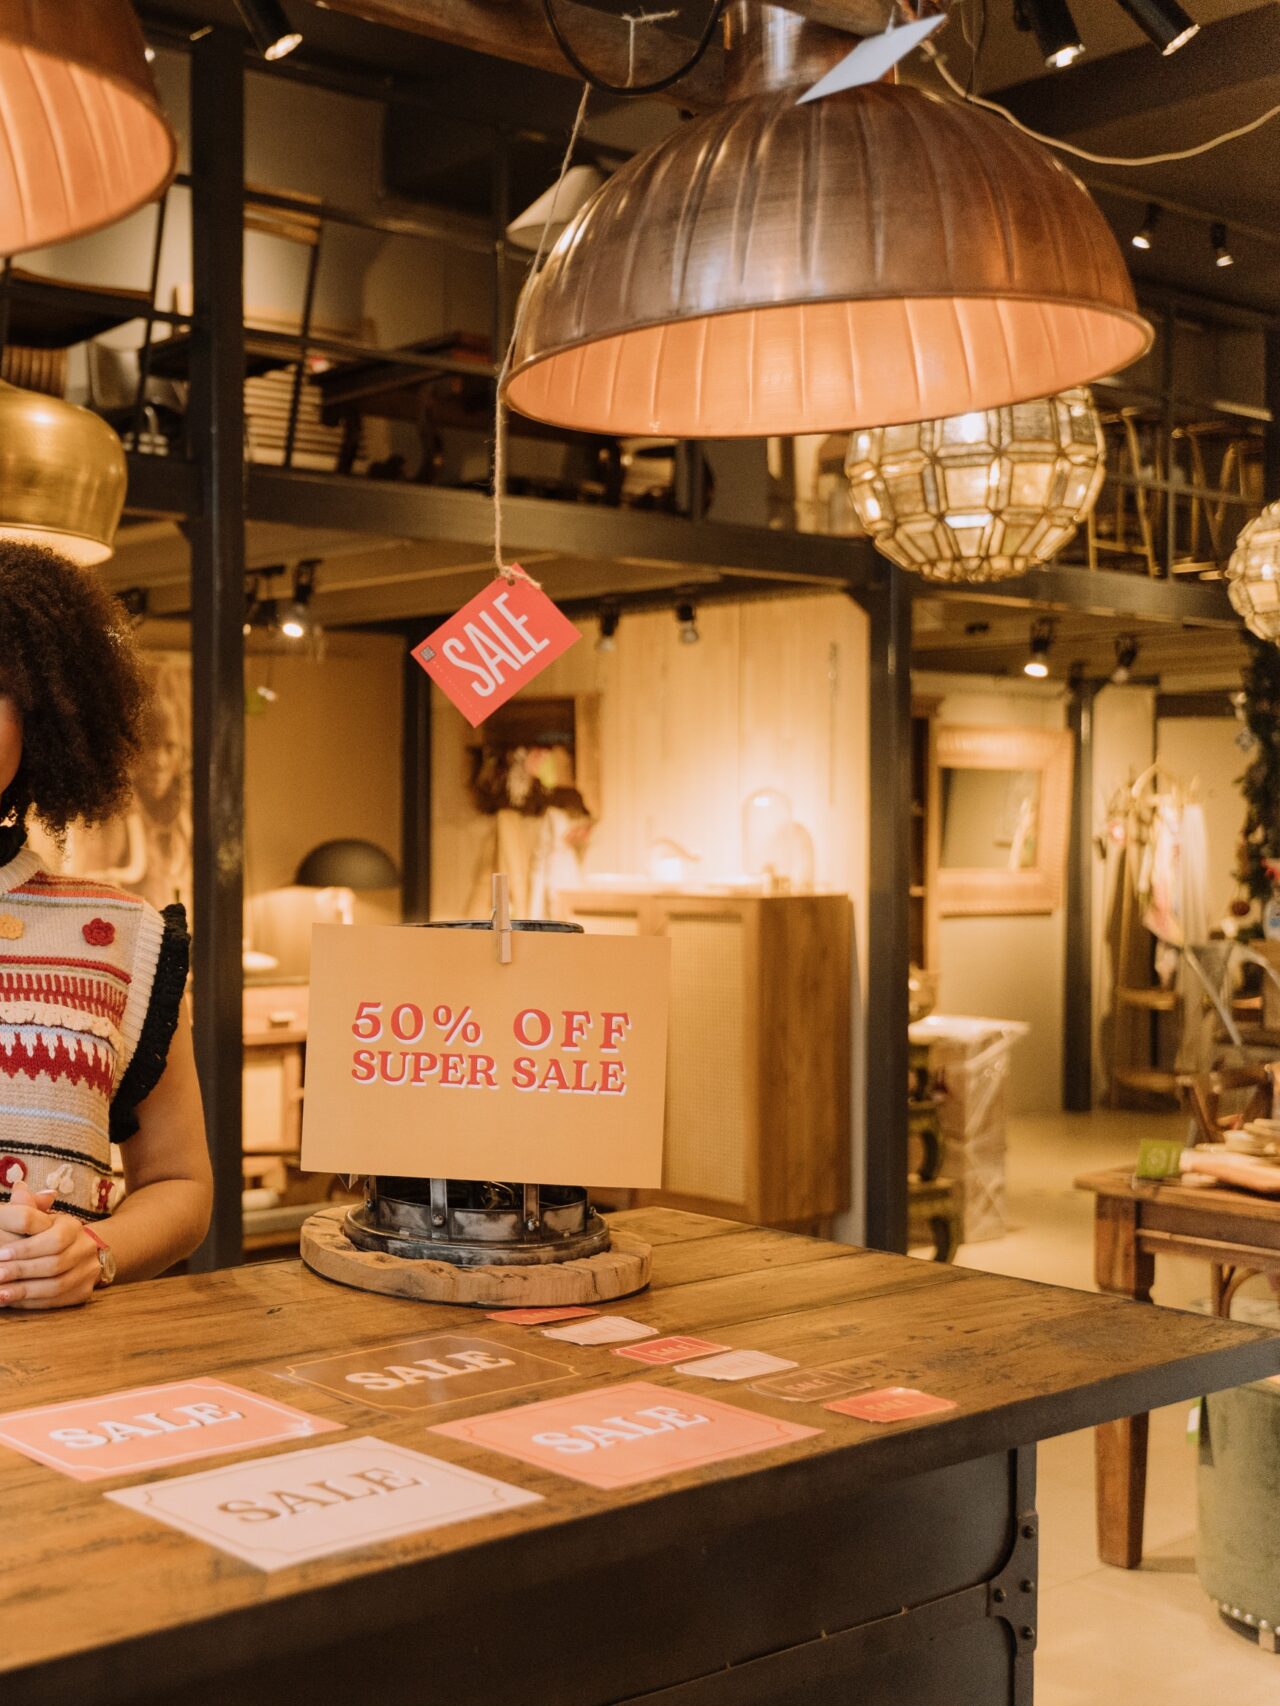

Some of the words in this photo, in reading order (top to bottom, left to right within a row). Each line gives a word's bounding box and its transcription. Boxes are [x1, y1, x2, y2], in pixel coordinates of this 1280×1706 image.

[442, 592, 550, 697] SALE
[351, 1002, 483, 1046] 50%
[513, 1008, 632, 1052] OFF
[351, 1050, 499, 1090] SUPER
[511, 1057, 628, 1096] SALE
[345, 1350, 516, 1391] SALE
[48, 1402, 245, 1450] SALE
[532, 1405, 712, 1454] SALE
[216, 1467, 426, 1523] SALE
